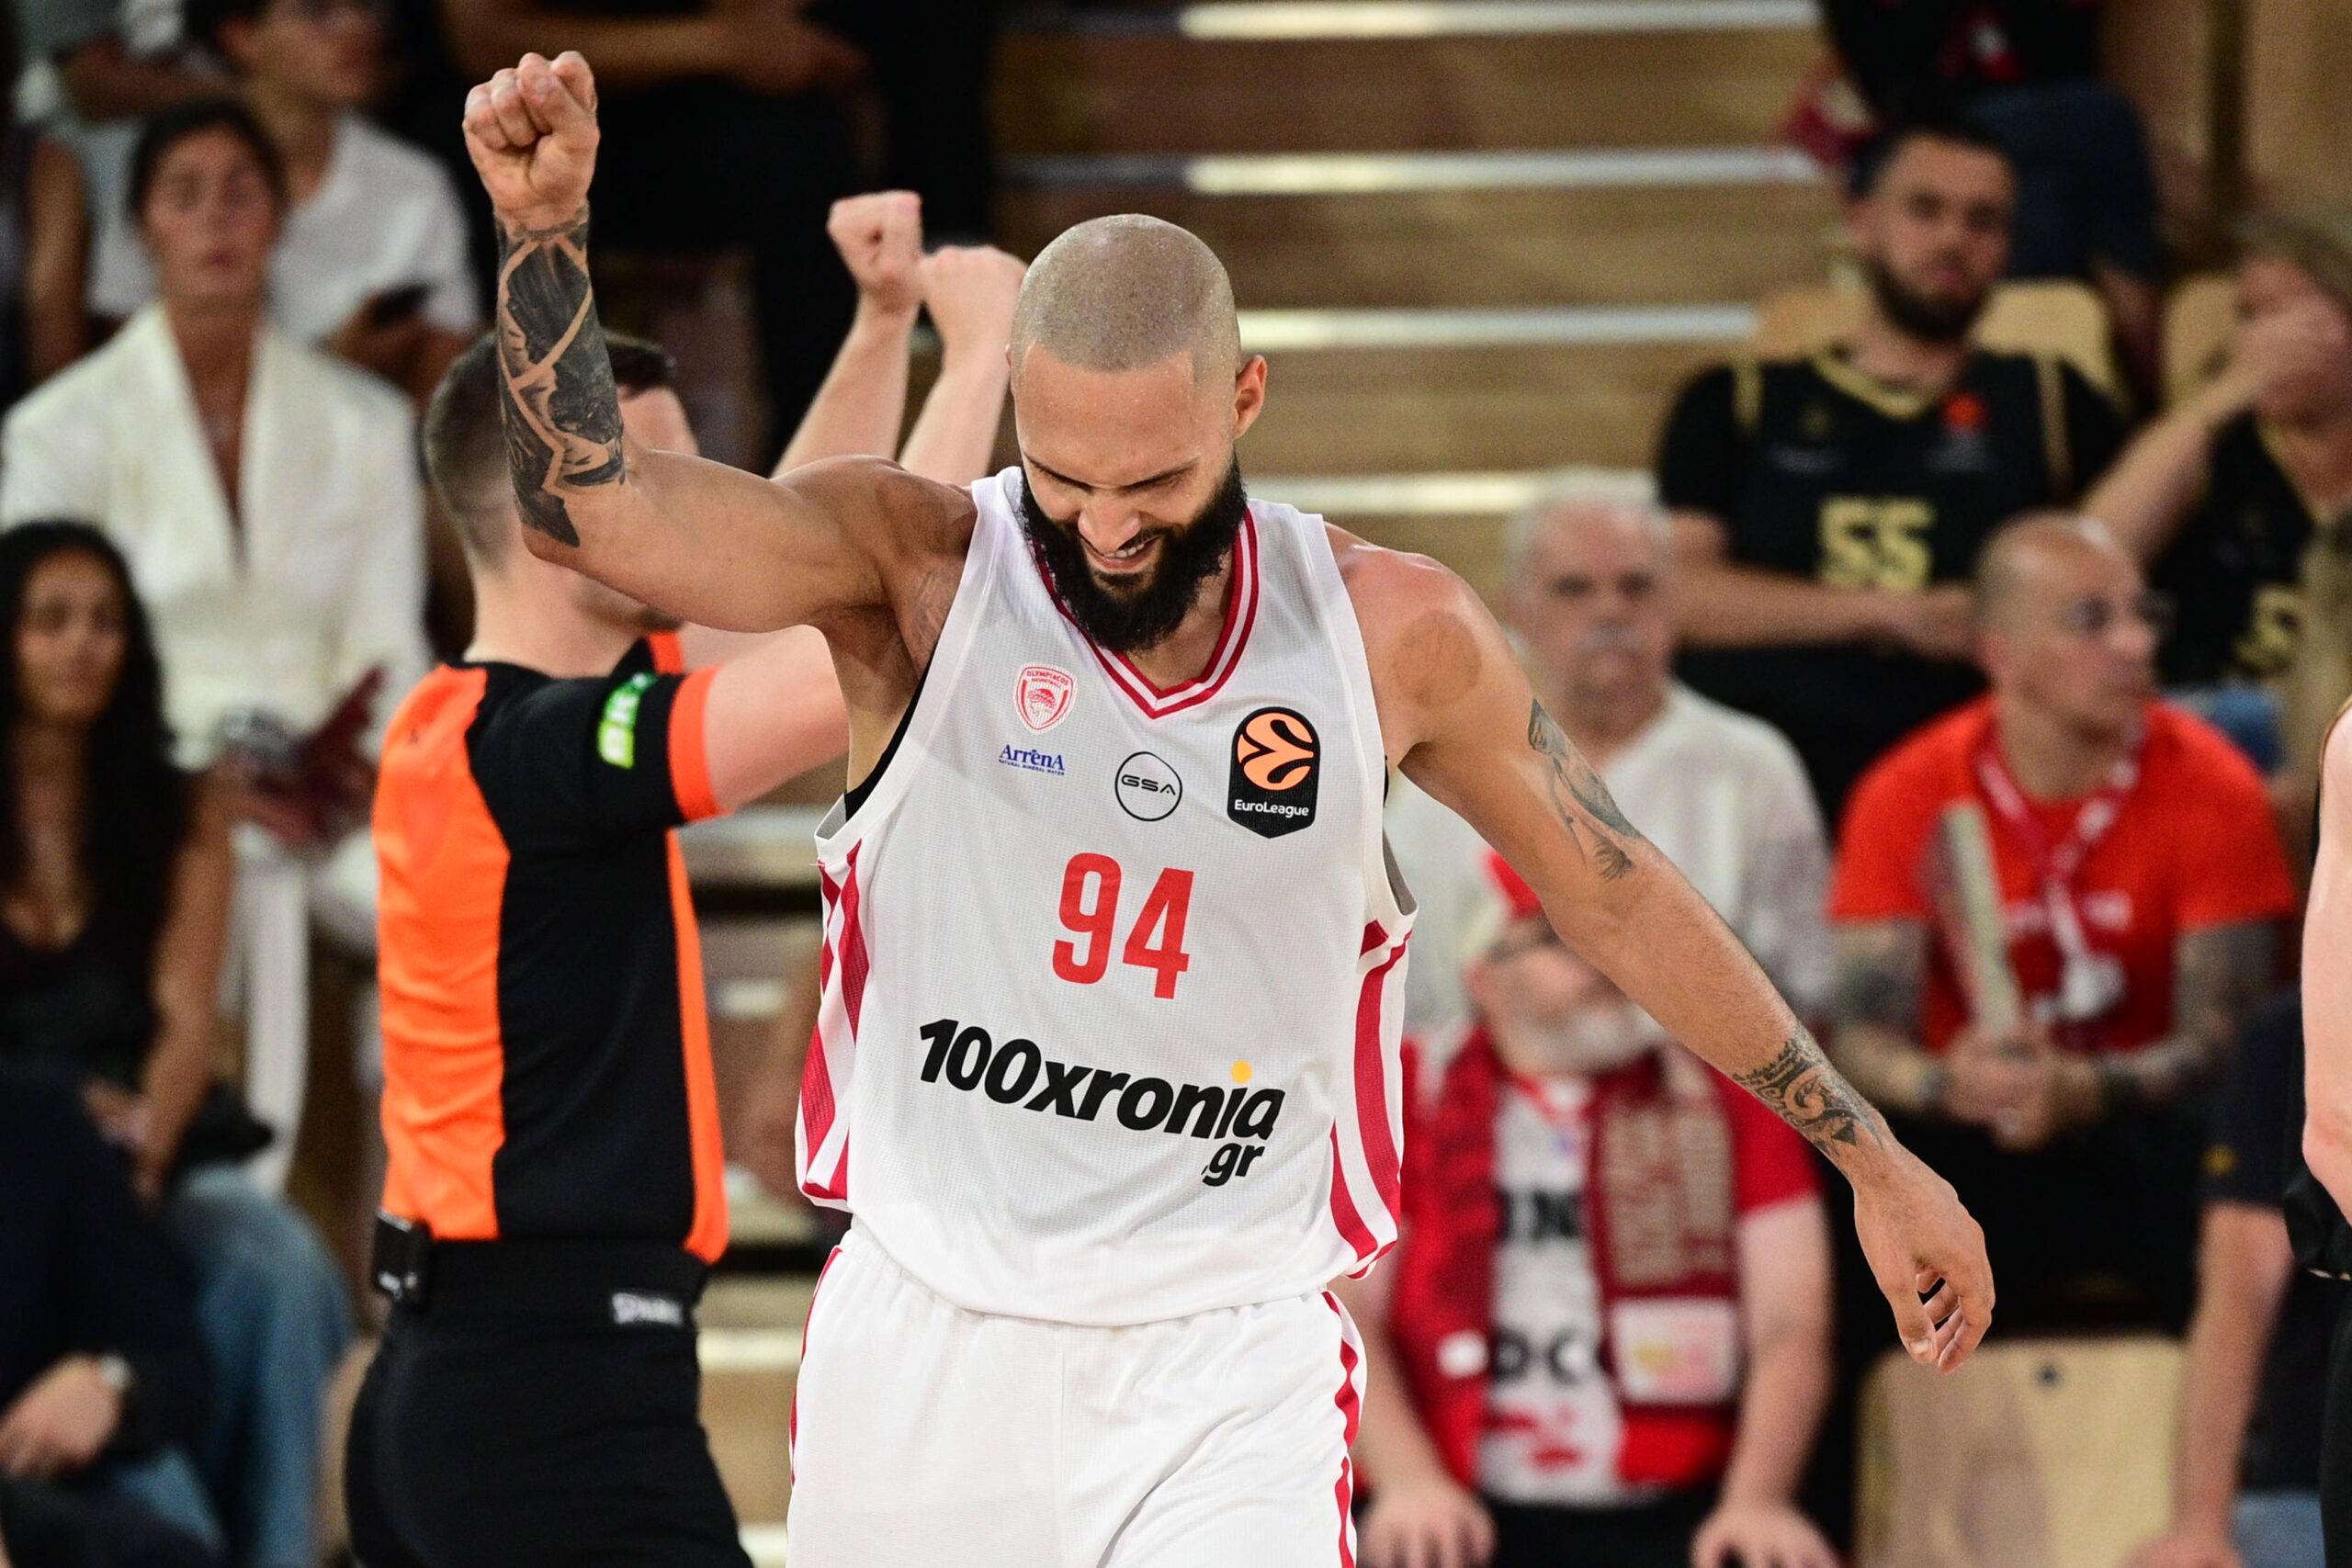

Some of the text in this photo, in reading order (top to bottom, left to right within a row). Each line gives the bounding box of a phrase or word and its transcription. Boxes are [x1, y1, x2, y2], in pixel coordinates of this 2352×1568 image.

[1121, 773, 1176, 795] GSA
[1234, 799, 1309, 818] EuroLeague
[1052, 852, 1194, 999] 94
[919, 1018, 1286, 1141] 100xronia
